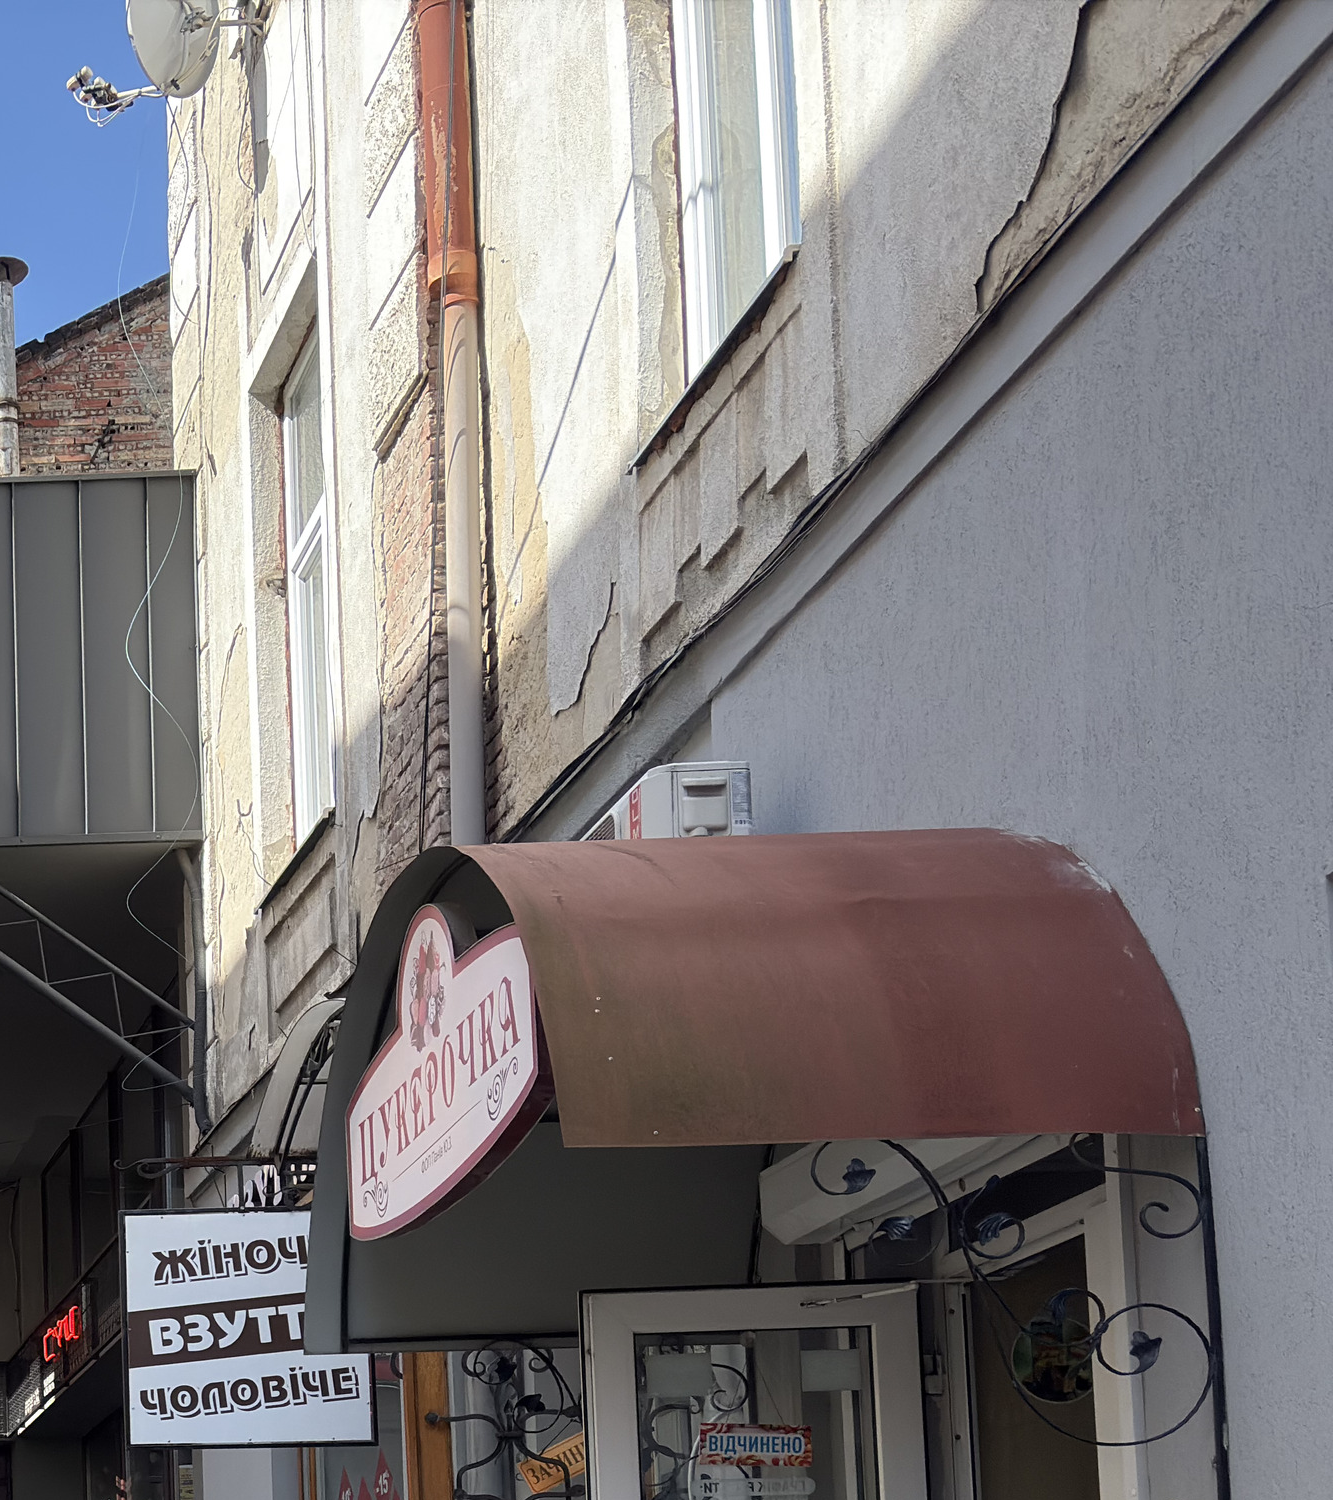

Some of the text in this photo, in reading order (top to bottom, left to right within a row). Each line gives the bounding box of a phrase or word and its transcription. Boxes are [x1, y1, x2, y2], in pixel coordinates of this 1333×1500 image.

[358, 976, 521, 1187] ЦУКЕРОЧКА
[152, 1235, 309, 1286] ЖІНОЧ
[148, 1304, 305, 1355] ВЗУТТ
[526, 1442, 585, 1485] ЗАЧИН
[708, 1434, 803, 1454] ВІДЧИНЕНО
